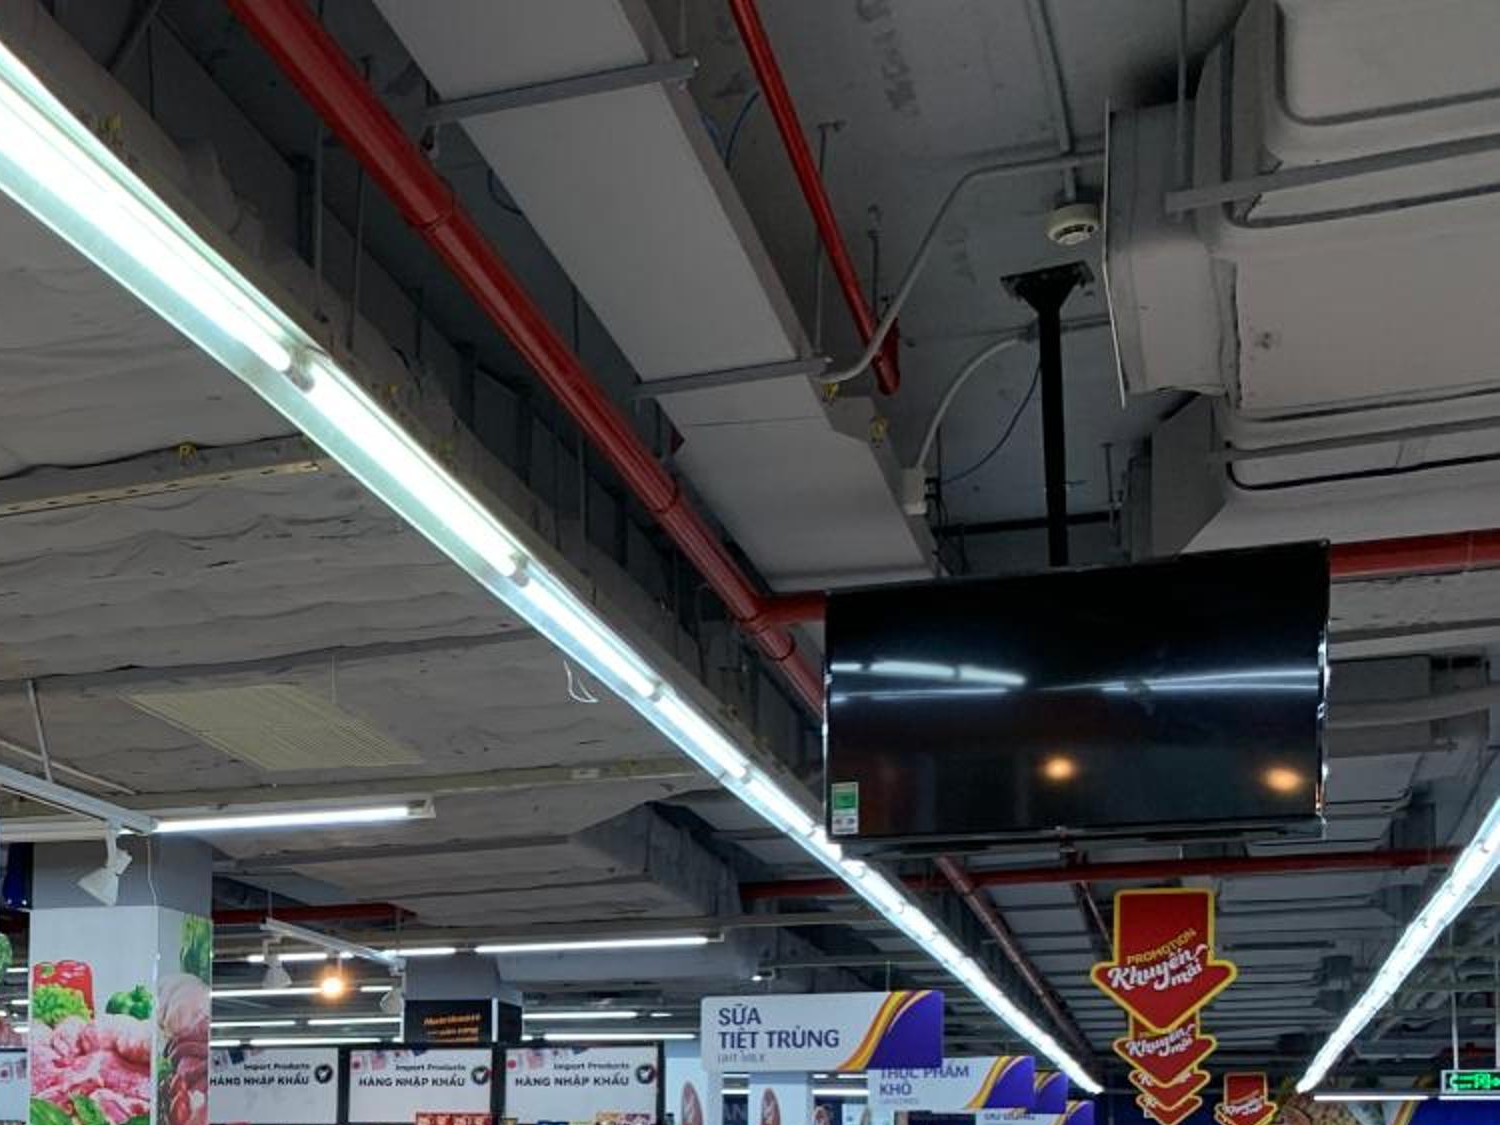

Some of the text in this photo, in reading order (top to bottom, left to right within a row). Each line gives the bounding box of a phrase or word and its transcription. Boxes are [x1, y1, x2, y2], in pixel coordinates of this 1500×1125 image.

[718, 1003, 761, 1026] SỮA
[717, 1025, 840, 1053] TIỆT TRÙNG
